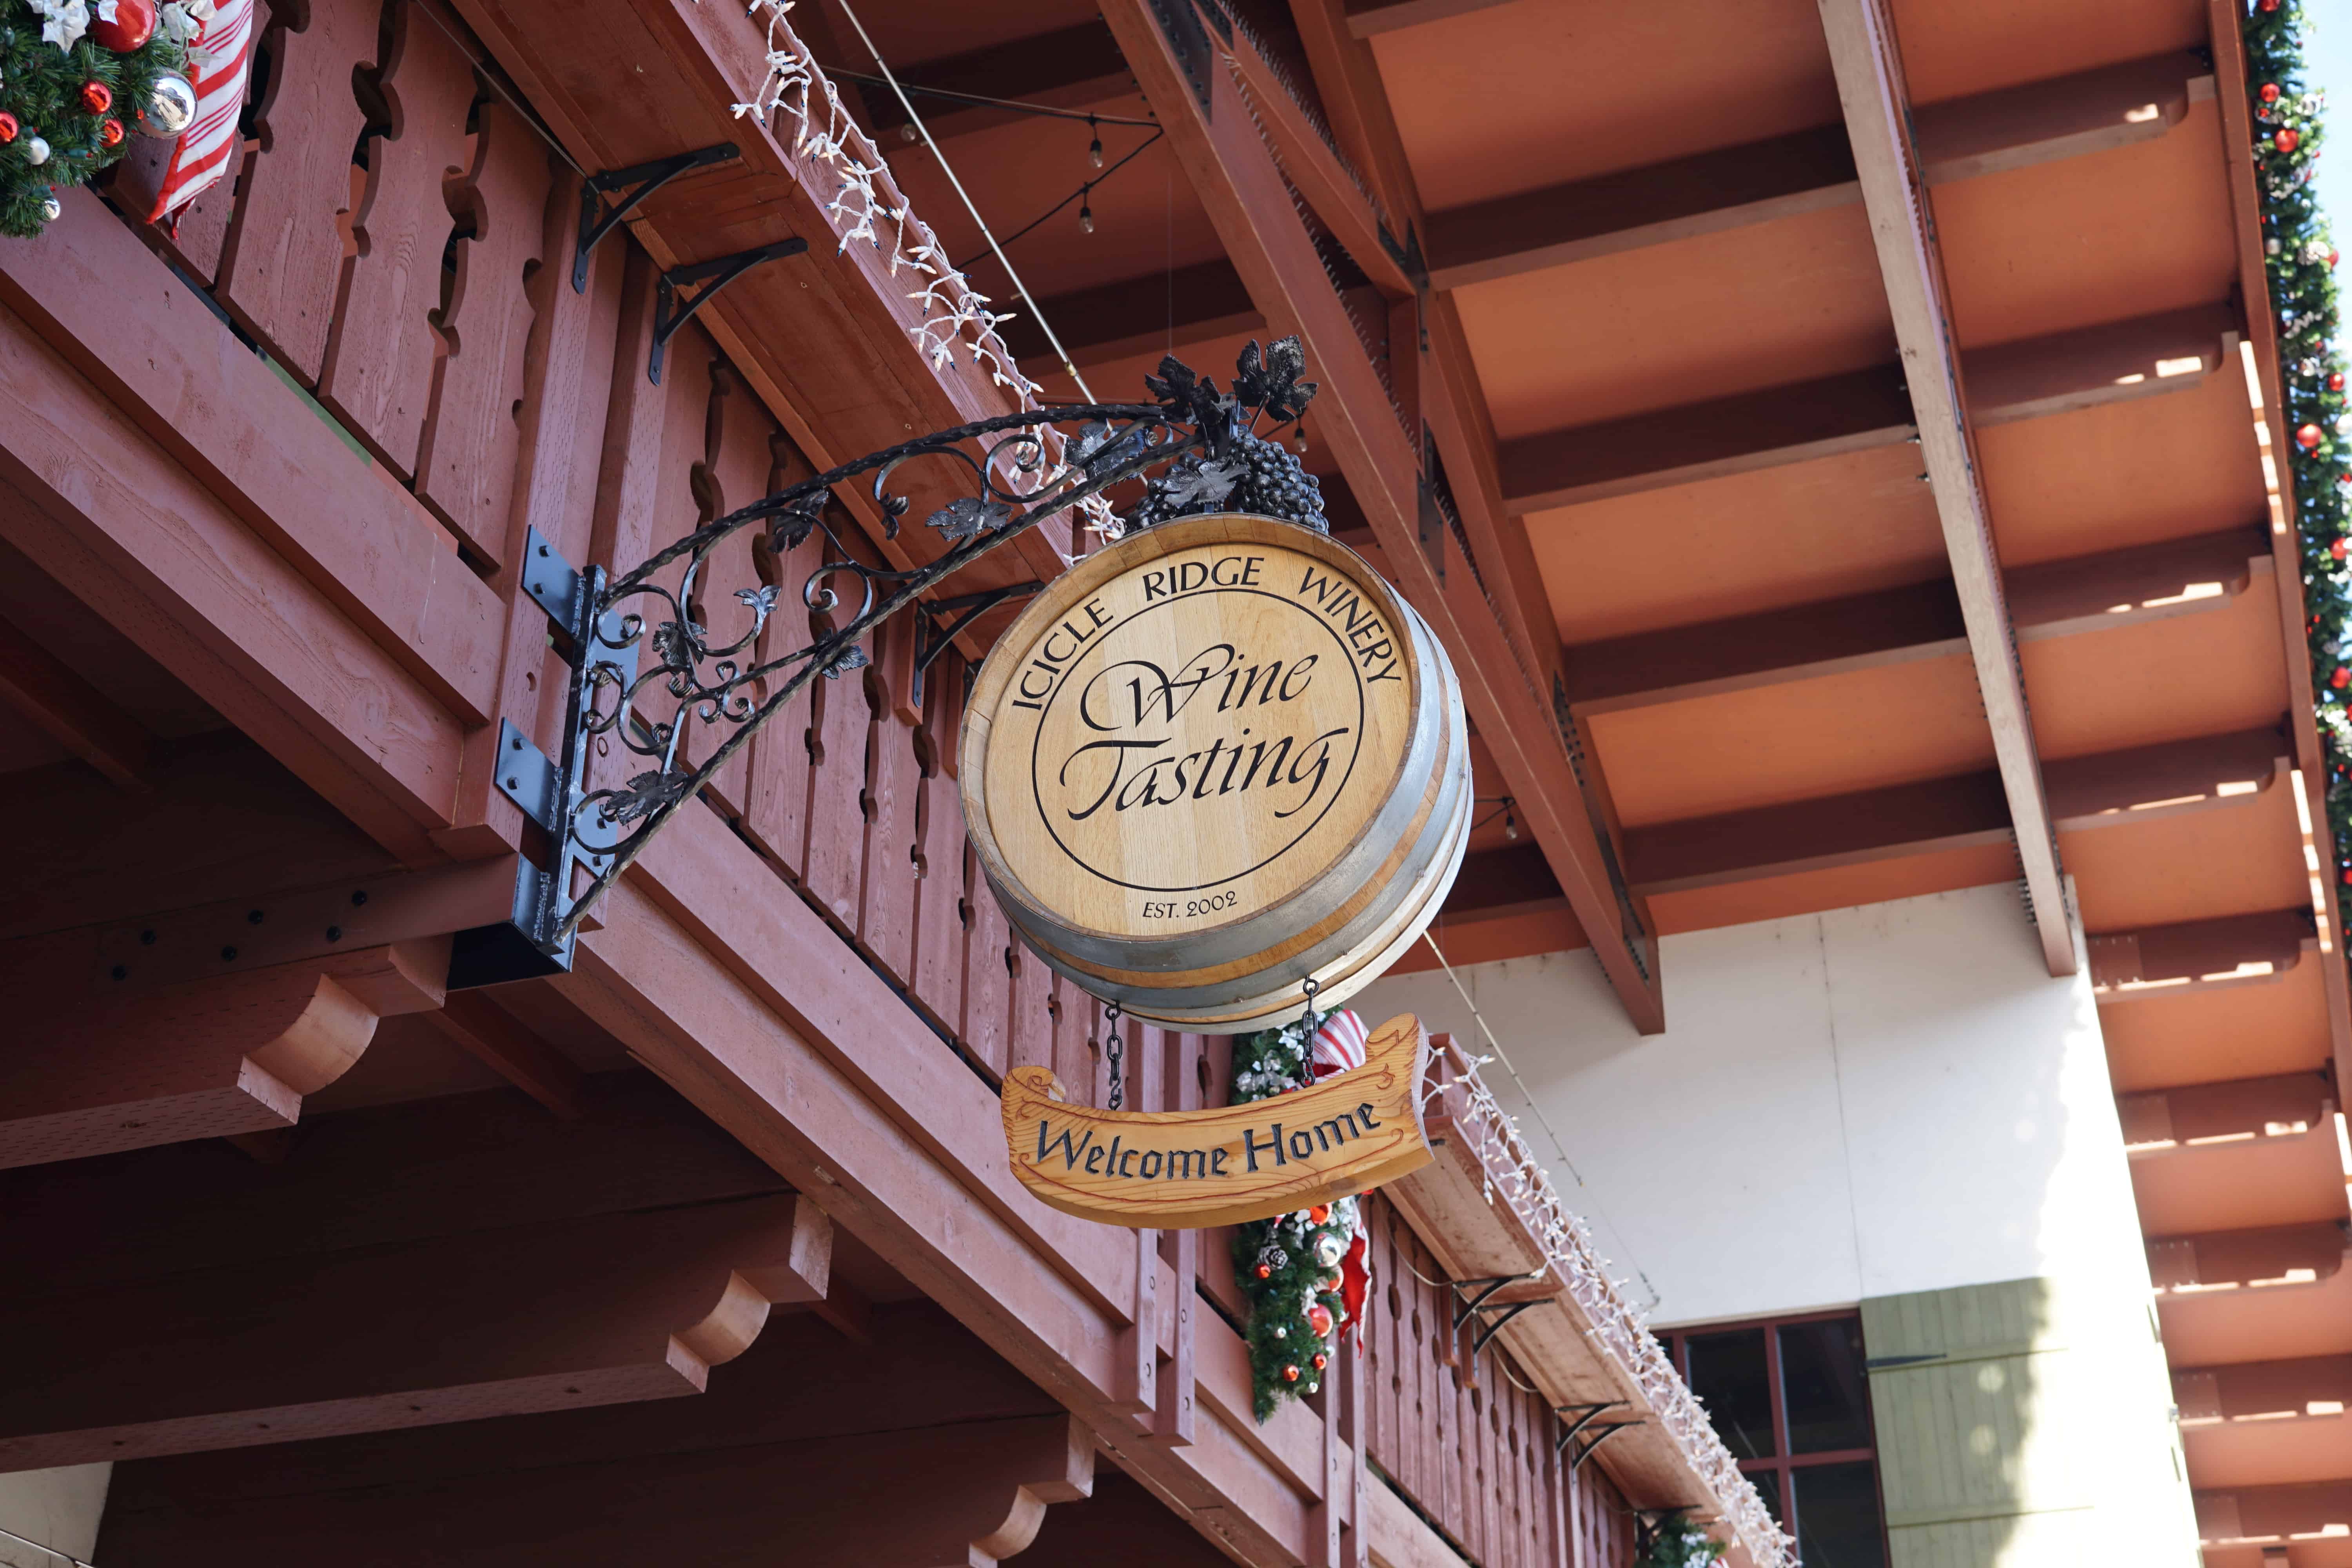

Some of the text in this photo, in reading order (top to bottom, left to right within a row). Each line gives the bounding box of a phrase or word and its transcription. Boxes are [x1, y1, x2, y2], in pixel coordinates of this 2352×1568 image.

[1013, 557, 1402, 710] ICICLE RIDGE WINERY
[1080, 643, 1319, 731] Wine
[1059, 727, 1350, 820] Tasting
[1142, 890, 1238, 919] EST. 2002
[1036, 1102, 1381, 1180] Welcome Home
